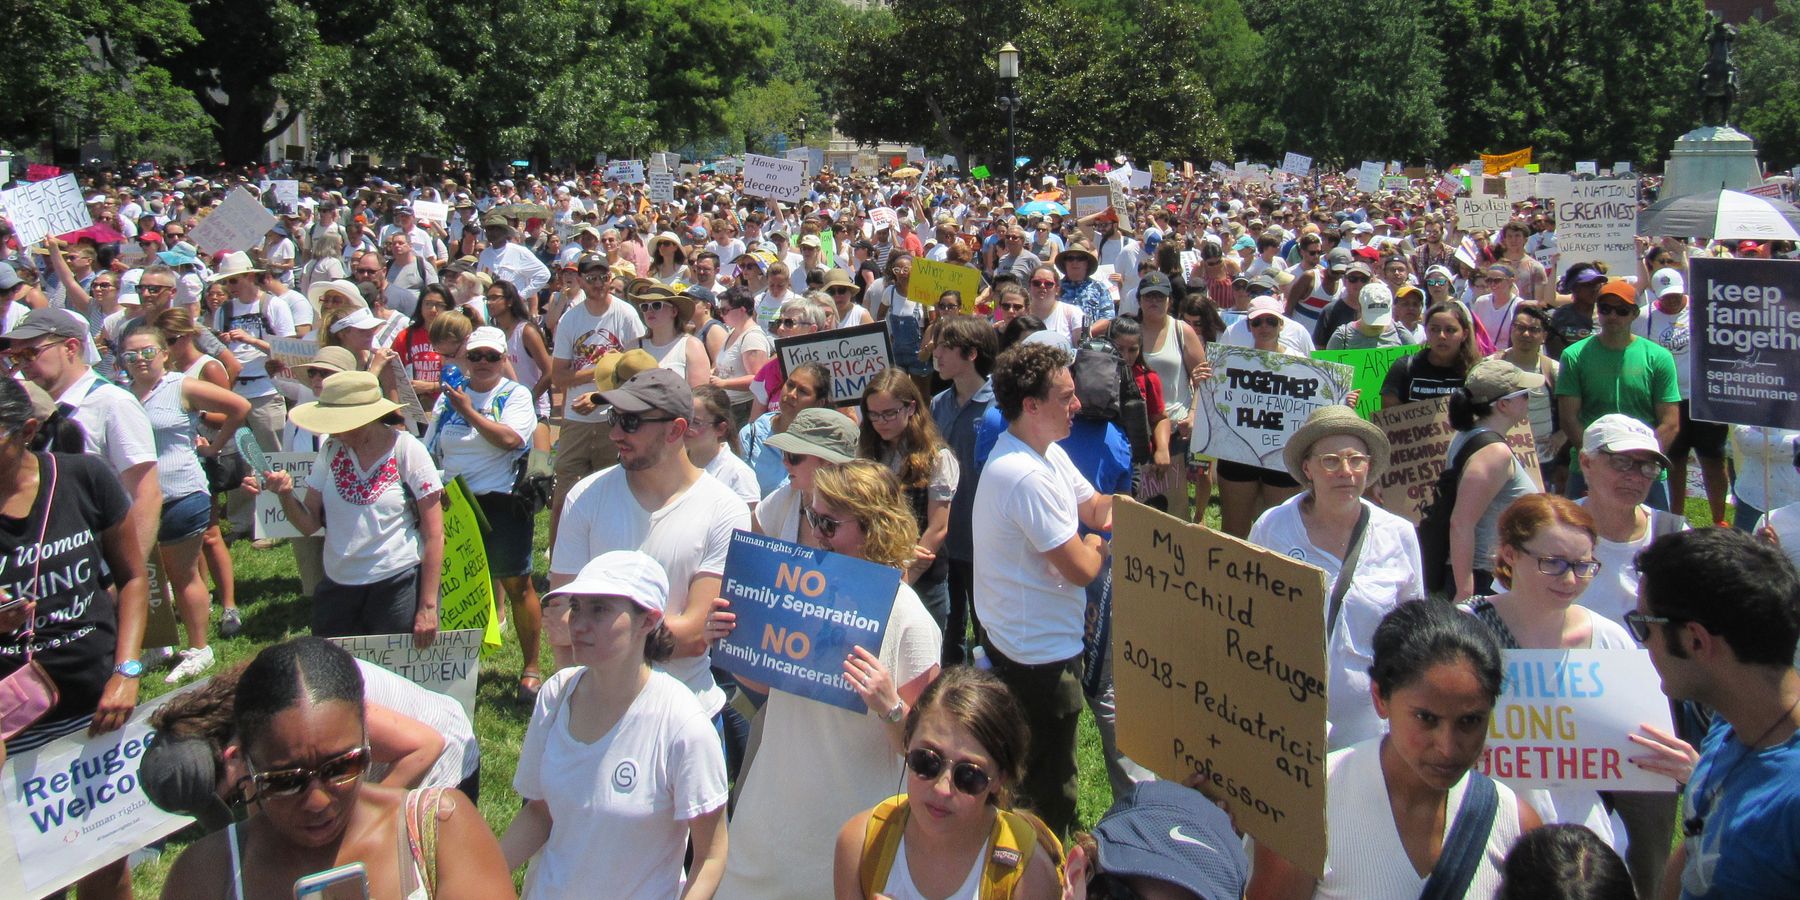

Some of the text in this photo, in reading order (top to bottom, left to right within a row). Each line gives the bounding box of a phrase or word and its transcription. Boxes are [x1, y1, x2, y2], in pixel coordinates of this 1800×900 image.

[751, 157, 775, 170] Have
[777, 162, 794, 173] you
[766, 171, 778, 181] no
[7, 174, 75, 207] WHERE
[743, 180, 800, 198] decency?
[1571, 186, 1582, 198] A
[1584, 184, 1636, 199] NATIONS
[37, 193, 73, 214] THE
[1559, 201, 1636, 221] GREATNESS
[1467, 213, 1505, 229] ICE
[1560, 242, 1635, 252] WEAKEST MEMBERS
[1707, 279, 1782, 303] keep
[1706, 328, 1800, 352] togeth
[788, 340, 879, 366] Kids in Cages
[416, 371, 441, 381] MERIC
[824, 356, 886, 377] RICA'S
[1706, 370, 1785, 386] separation
[1226, 367, 1319, 400] TOGETHER
[1708, 381, 1798, 401] is inhumane
[1224, 390, 1233, 402] IS
[1236, 407, 1284, 430] PLACE
[1372, 413, 1381, 426] A
[1382, 409, 1400, 426] few
[1403, 406, 1432, 421] verses
[1262, 434, 1281, 446] BE
[1387, 429, 1413, 445] OVE
[1381, 466, 1416, 489] LOVE
[1417, 463, 1429, 481] IS
[1407, 485, 1425, 500] OF
[456, 538, 475, 561] THE
[734, 533, 815, 560] human rights first
[440, 553, 487, 599] ILD ABUSE
[1152, 528, 1303, 602] My Father
[775, 562, 826, 598] NO
[440, 581, 489, 628] REUNITE
[726, 578, 880, 633] Family Separation
[0, 644, 22, 656] ust
[341, 637, 374, 651] ELL
[761, 623, 810, 660] NO
[407, 648, 457, 665] DONE
[462, 645, 480, 660] TO
[1226, 628, 1326, 702] Refugee
[393, 662, 467, 685] ILDREN
[719, 639, 862, 695] Family Incarceratio
[1500, 661, 1605, 698] MILIES
[1489, 704, 1576, 741] LONG
[23, 731, 157, 807] Refugee
[1276, 754, 1314, 789] an
[1474, 745, 1623, 780] OGETHER
[1173, 737, 1287, 823] Professor
[30, 769, 142, 834] Welco
[82, 813, 117, 835] human
[119, 799, 147, 817] rights
